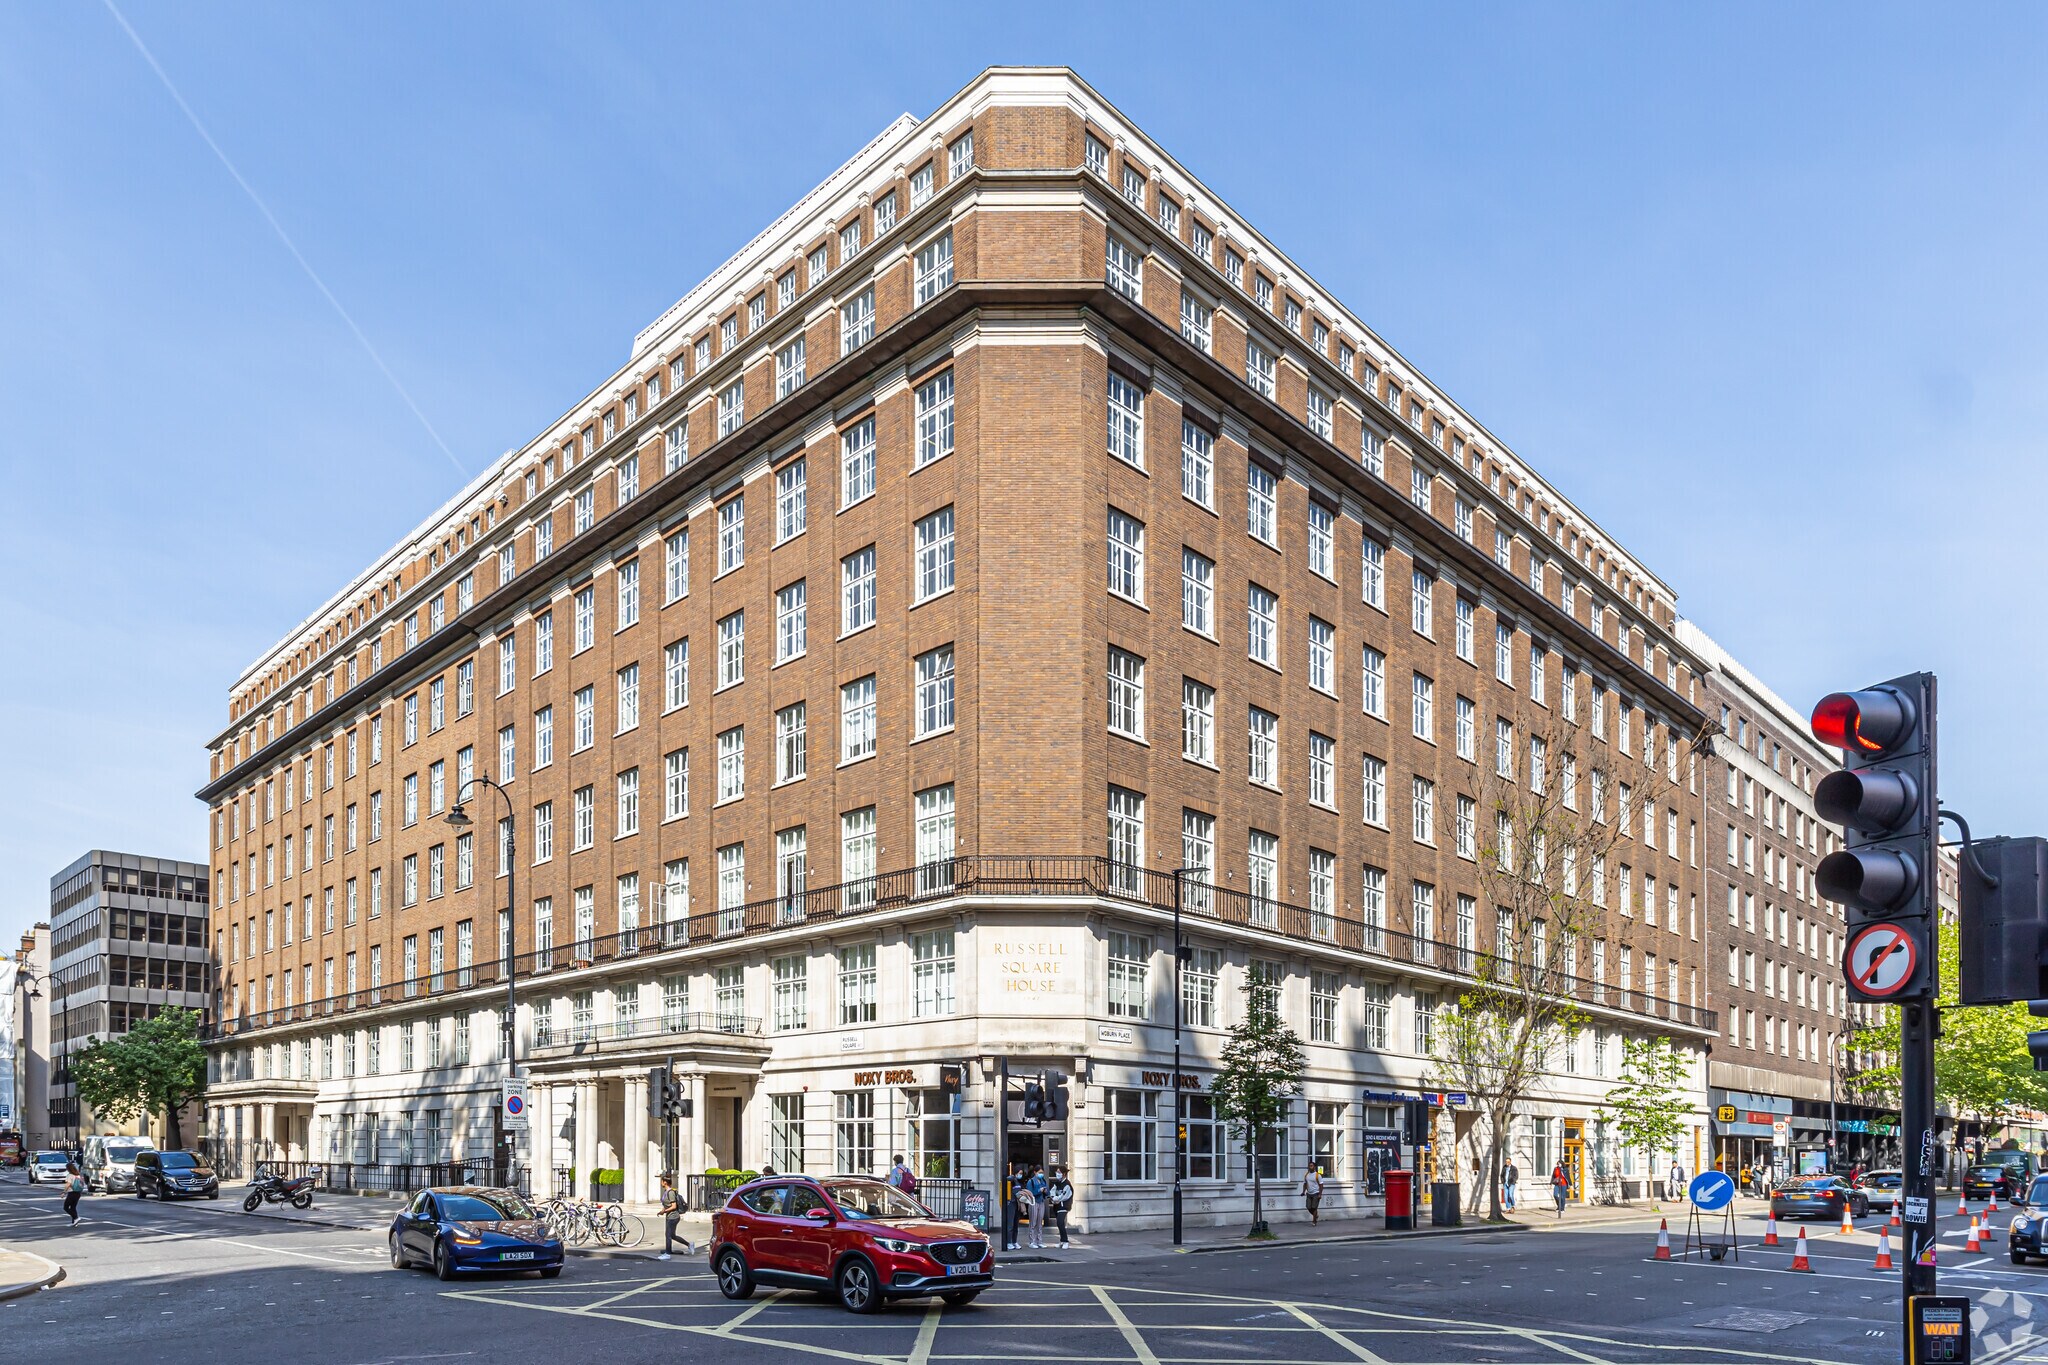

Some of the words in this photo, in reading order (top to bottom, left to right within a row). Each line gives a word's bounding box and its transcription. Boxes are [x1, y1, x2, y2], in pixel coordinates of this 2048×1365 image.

[995, 943, 1067, 955] RUSSELL
[1002, 961, 1061, 974] SQUARE
[1008, 979, 1055, 991] HOUSE
[1101, 1030, 1118, 1038] WOBURN
[854, 1071, 882, 1086] NOXY
[884, 1069, 917, 1084] BROS.
[1141, 1071, 1171, 1086] NOXY
[950, 1266, 966, 1274] LV20
[967, 1265, 978, 1273] LKL
[1925, 1323, 1960, 1335] WAIT
